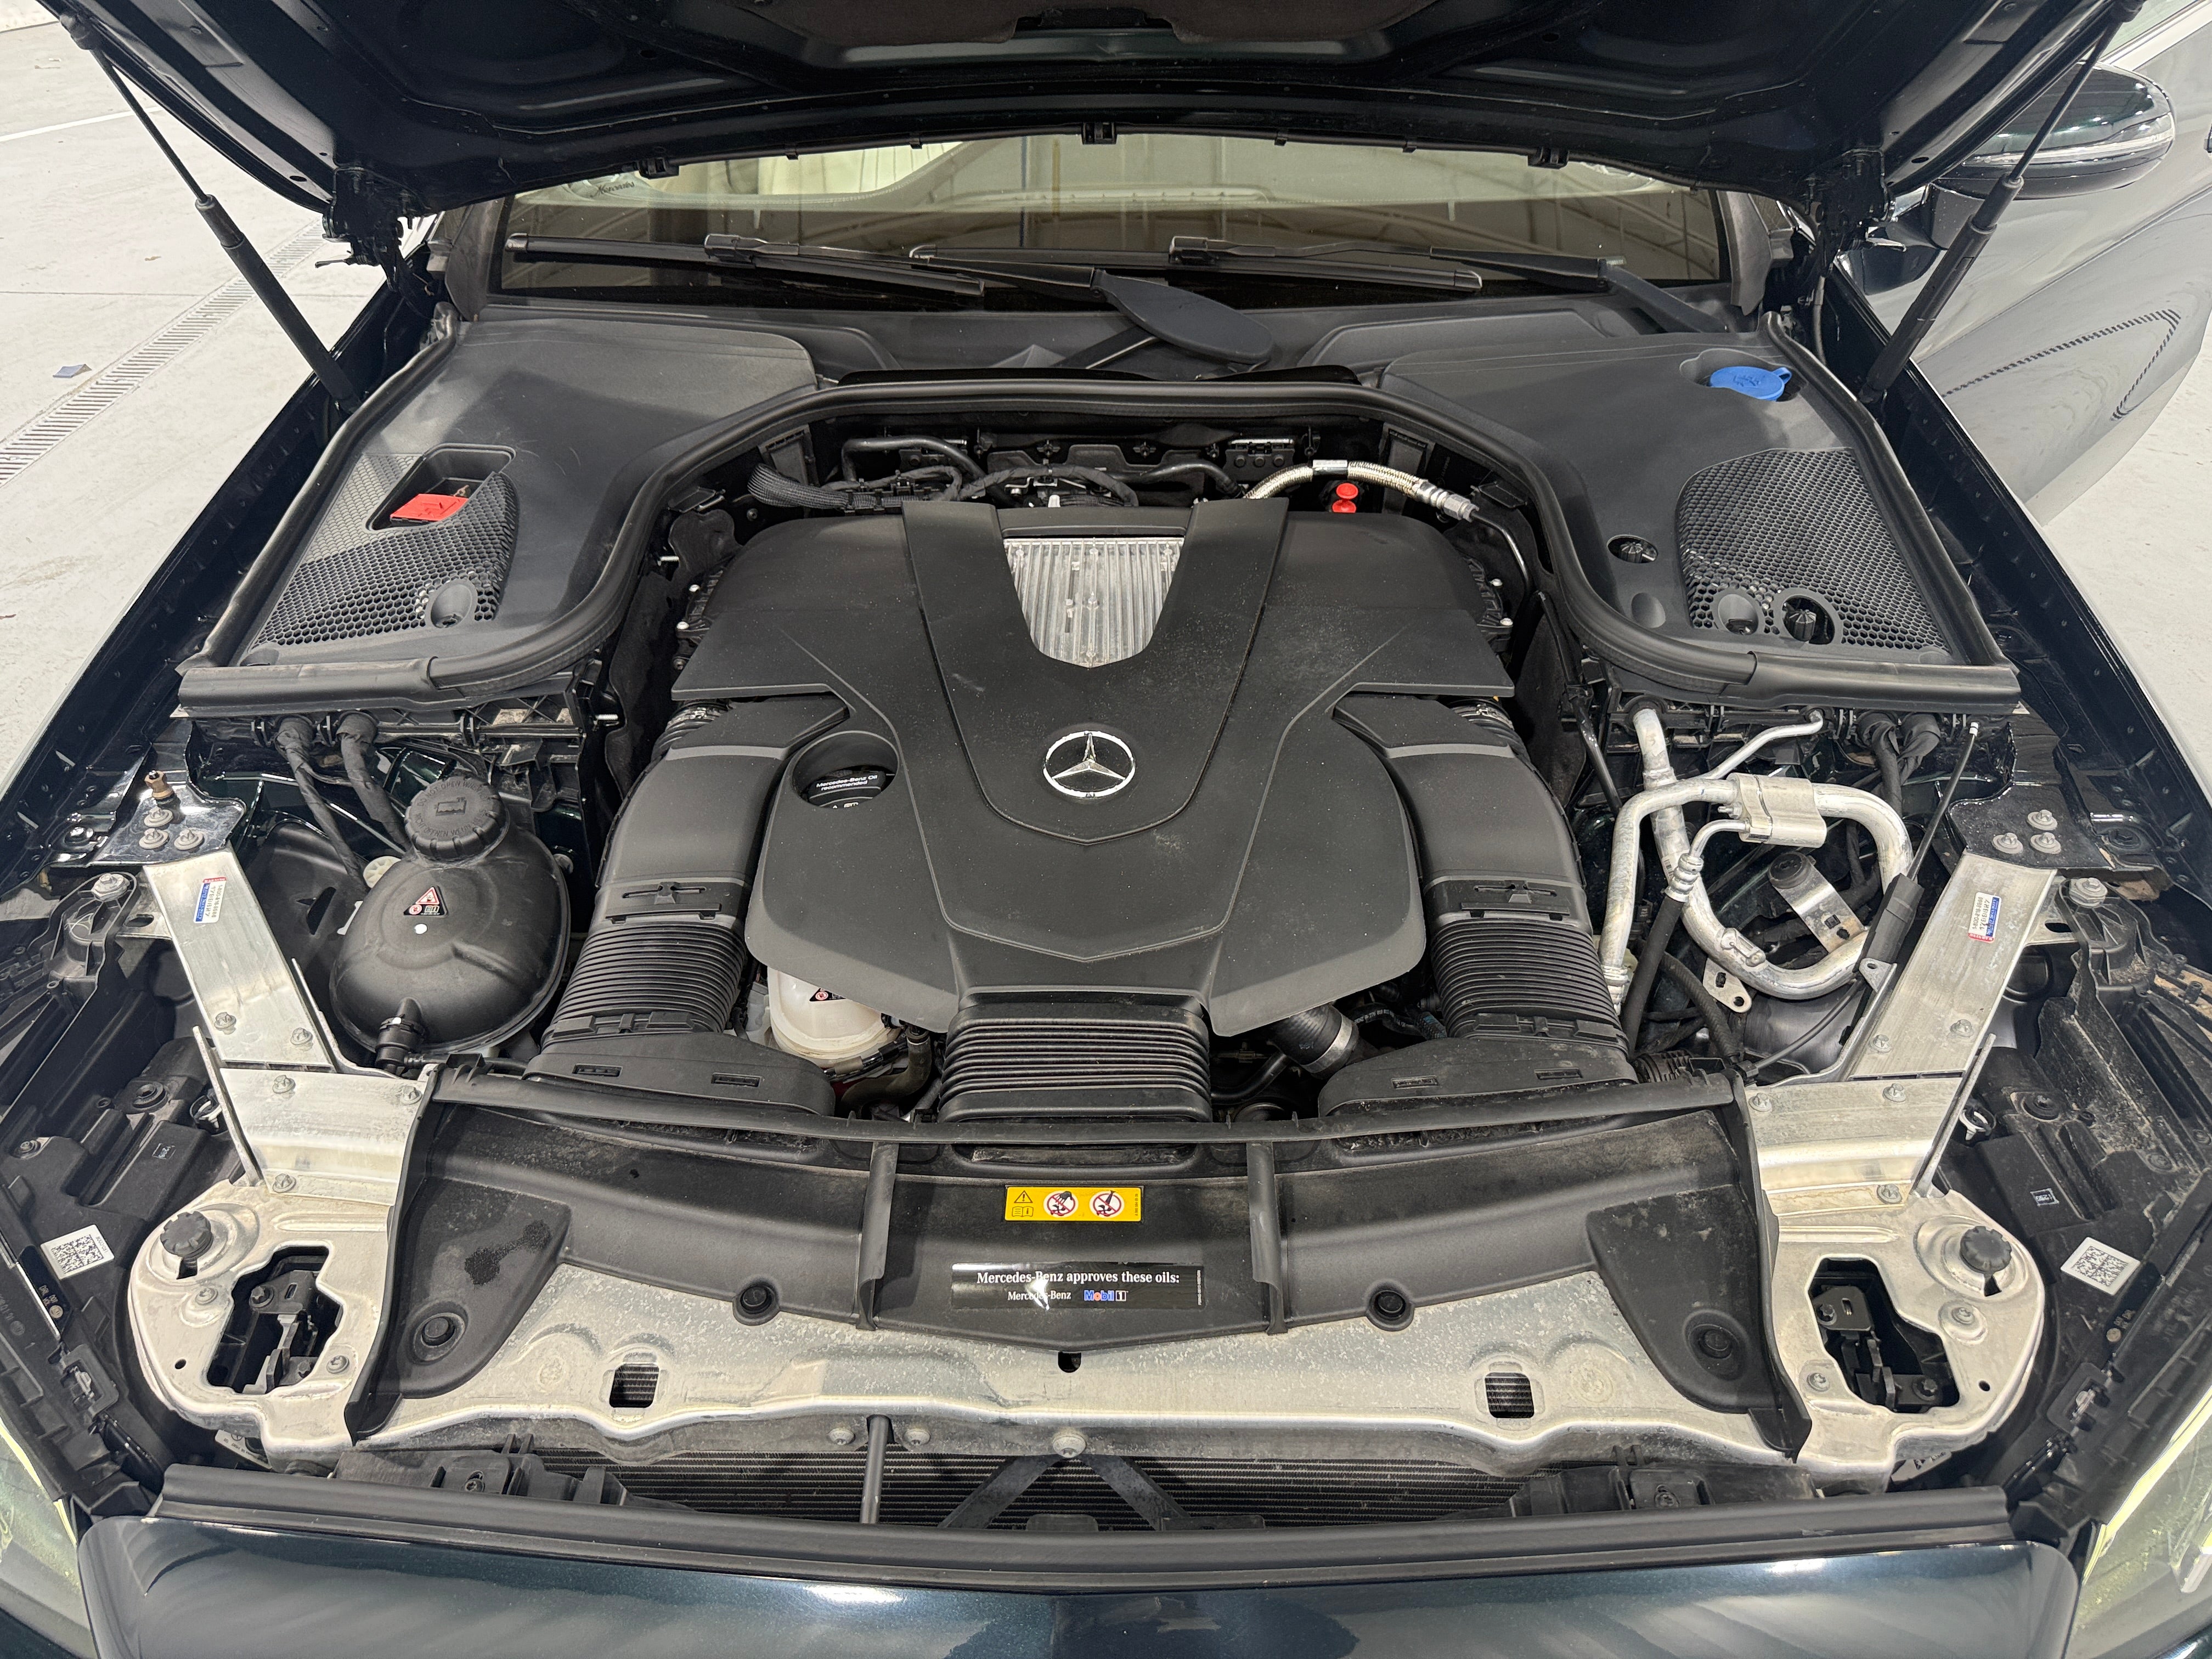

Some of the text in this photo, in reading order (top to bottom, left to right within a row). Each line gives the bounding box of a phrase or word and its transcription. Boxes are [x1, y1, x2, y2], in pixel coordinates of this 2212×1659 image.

[441, 781, 461, 789] OPEN
[816, 776, 867, 788] Mercedes-Benz
[821, 780, 868, 791] recommended
[977, 1271, 1180, 1284] Mercedes-Benz approves these oils:
[1007, 1290, 1071, 1301] Mercedes-Benz
[1084, 1290, 1115, 1301] Mobil
